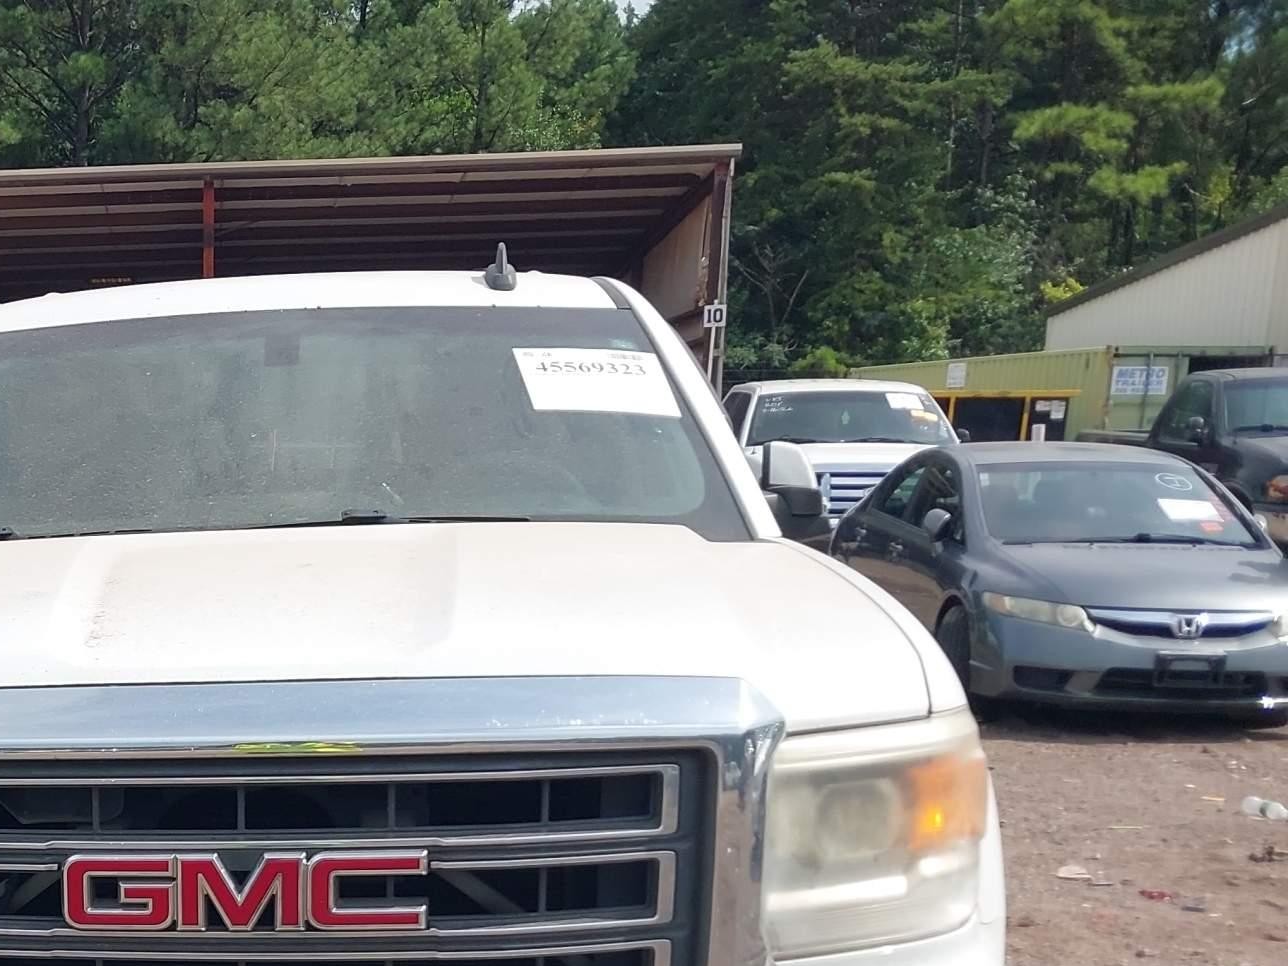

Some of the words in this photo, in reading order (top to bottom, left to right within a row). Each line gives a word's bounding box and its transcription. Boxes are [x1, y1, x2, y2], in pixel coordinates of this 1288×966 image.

[706, 308, 723, 324] 10
[535, 360, 647, 377] 45569323
[62, 850, 428, 932] GMC
